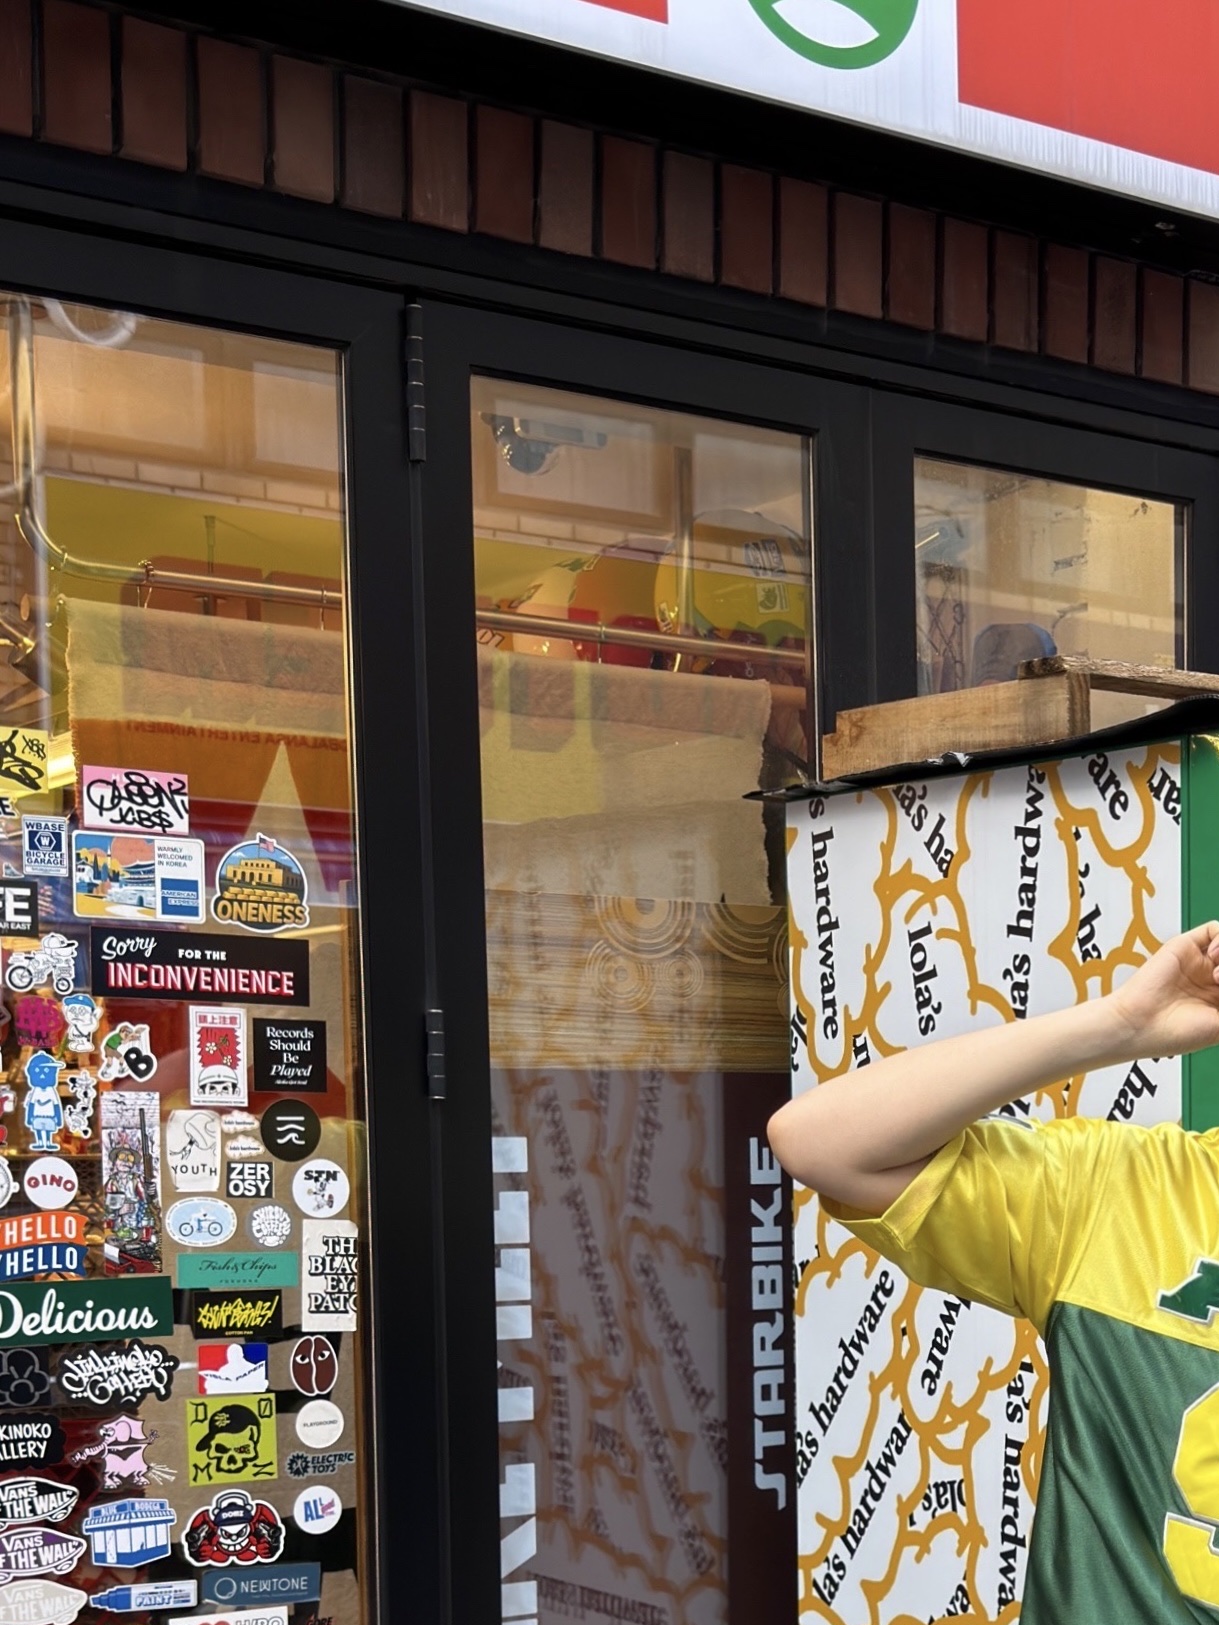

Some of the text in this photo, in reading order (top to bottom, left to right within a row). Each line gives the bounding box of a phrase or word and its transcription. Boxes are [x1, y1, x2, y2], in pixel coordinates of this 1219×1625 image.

[26, 822, 65, 832] WBASE
[26, 851, 66, 860] BICYCLE
[157, 846, 184, 854] WARMLY
[157, 853, 194, 862] WELCOMED
[26, 858, 66, 867] GARAGE
[161, 890, 197, 899] AMERICAN
[217, 900, 307, 925] ONENESS
[11, 923, 31, 931] EAST
[812, 826, 841, 1041] hardware
[101, 936, 158, 961] Sorry
[178, 949, 227, 961] FOR THE
[108, 962, 295, 997] INCONVENIENCE
[907, 921, 943, 1037] lola's
[266, 1026, 314, 1039] Records
[269, 1040, 311, 1052] Should
[283, 1053, 299, 1064] Be
[270, 1065, 313, 1078] Played
[171, 1163, 217, 1177] YOUTH
[230, 1163, 270, 1180] ZER
[229, 1180, 271, 1197] OSY
[5, 1215, 77, 1246] HELLO
[6, 1247, 78, 1276] HELLO
[325, 1274, 358, 1294] EY
[0, 1288, 158, 1338] Delicious
[750, 1136, 786, 1511] STARBIKE
[808, 1269, 895, 1437] hardware
[303, 1418, 338, 1428] PLAYGROUND
[311, 1453, 354, 1466] ELECTRIC
[311, 1463, 337, 1474] TOYS
[3, 1498, 30, 1518] THE
[2, 1532, 43, 1550] VANS
[8, 1551, 38, 1570] THE
[240, 1577, 308, 1593] NEWTONE
[136, 1594, 172, 1608] PAINT
